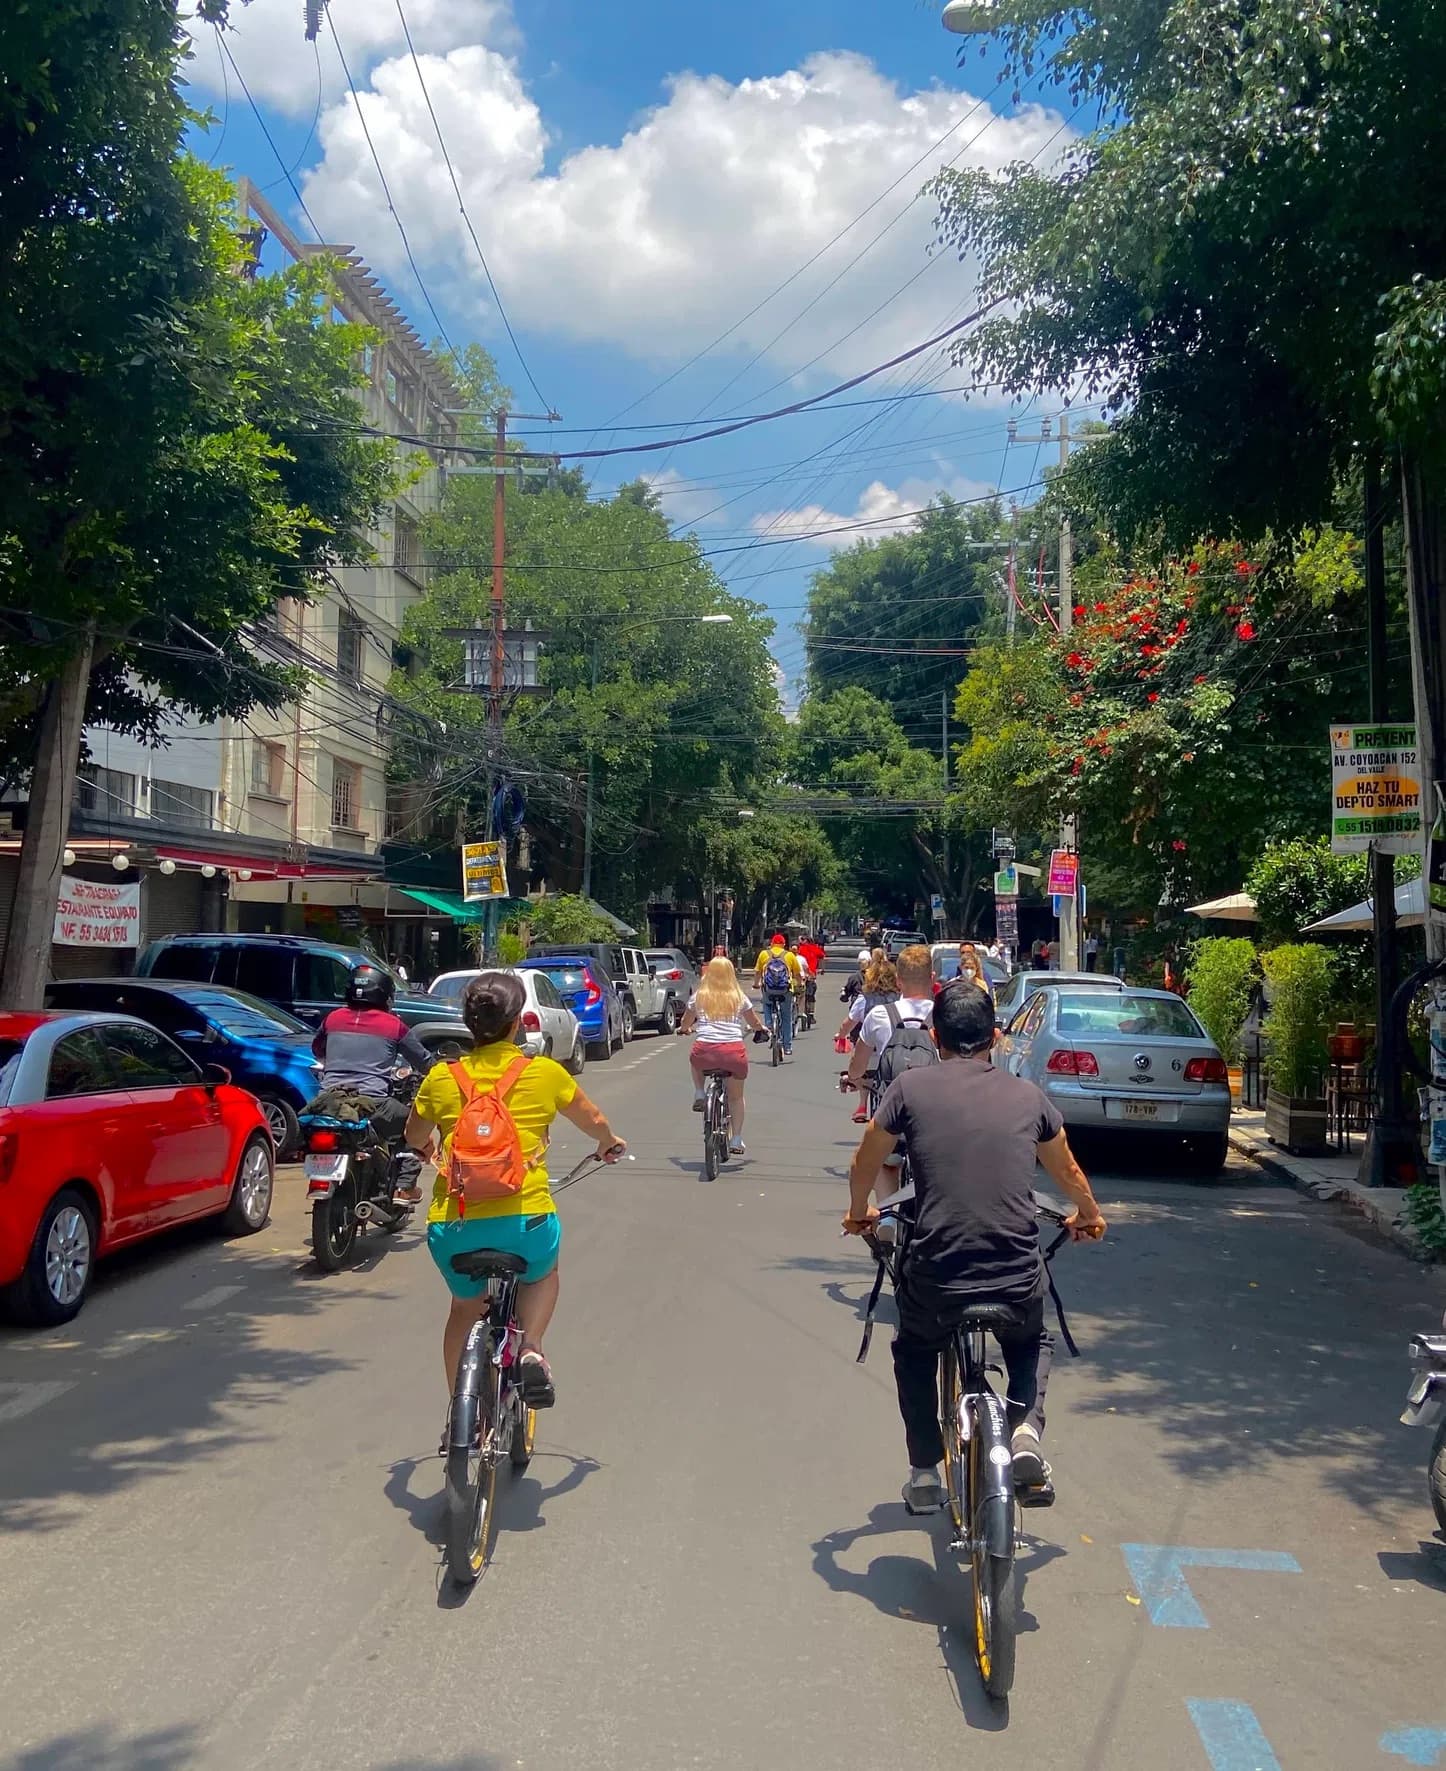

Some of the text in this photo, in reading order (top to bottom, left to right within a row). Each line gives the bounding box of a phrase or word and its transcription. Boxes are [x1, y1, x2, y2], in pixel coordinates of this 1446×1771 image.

[1355, 730, 1416, 747] PREVENT
[1335, 755, 1348, 767] AV.
[1401, 752, 1416, 765] 152
[1357, 780, 1399, 794] HAZ TU
[1336, 794, 1419, 809] DEPTO SMART
[1346, 822, 1357, 832] 55
[79, 923, 92, 940] 55
